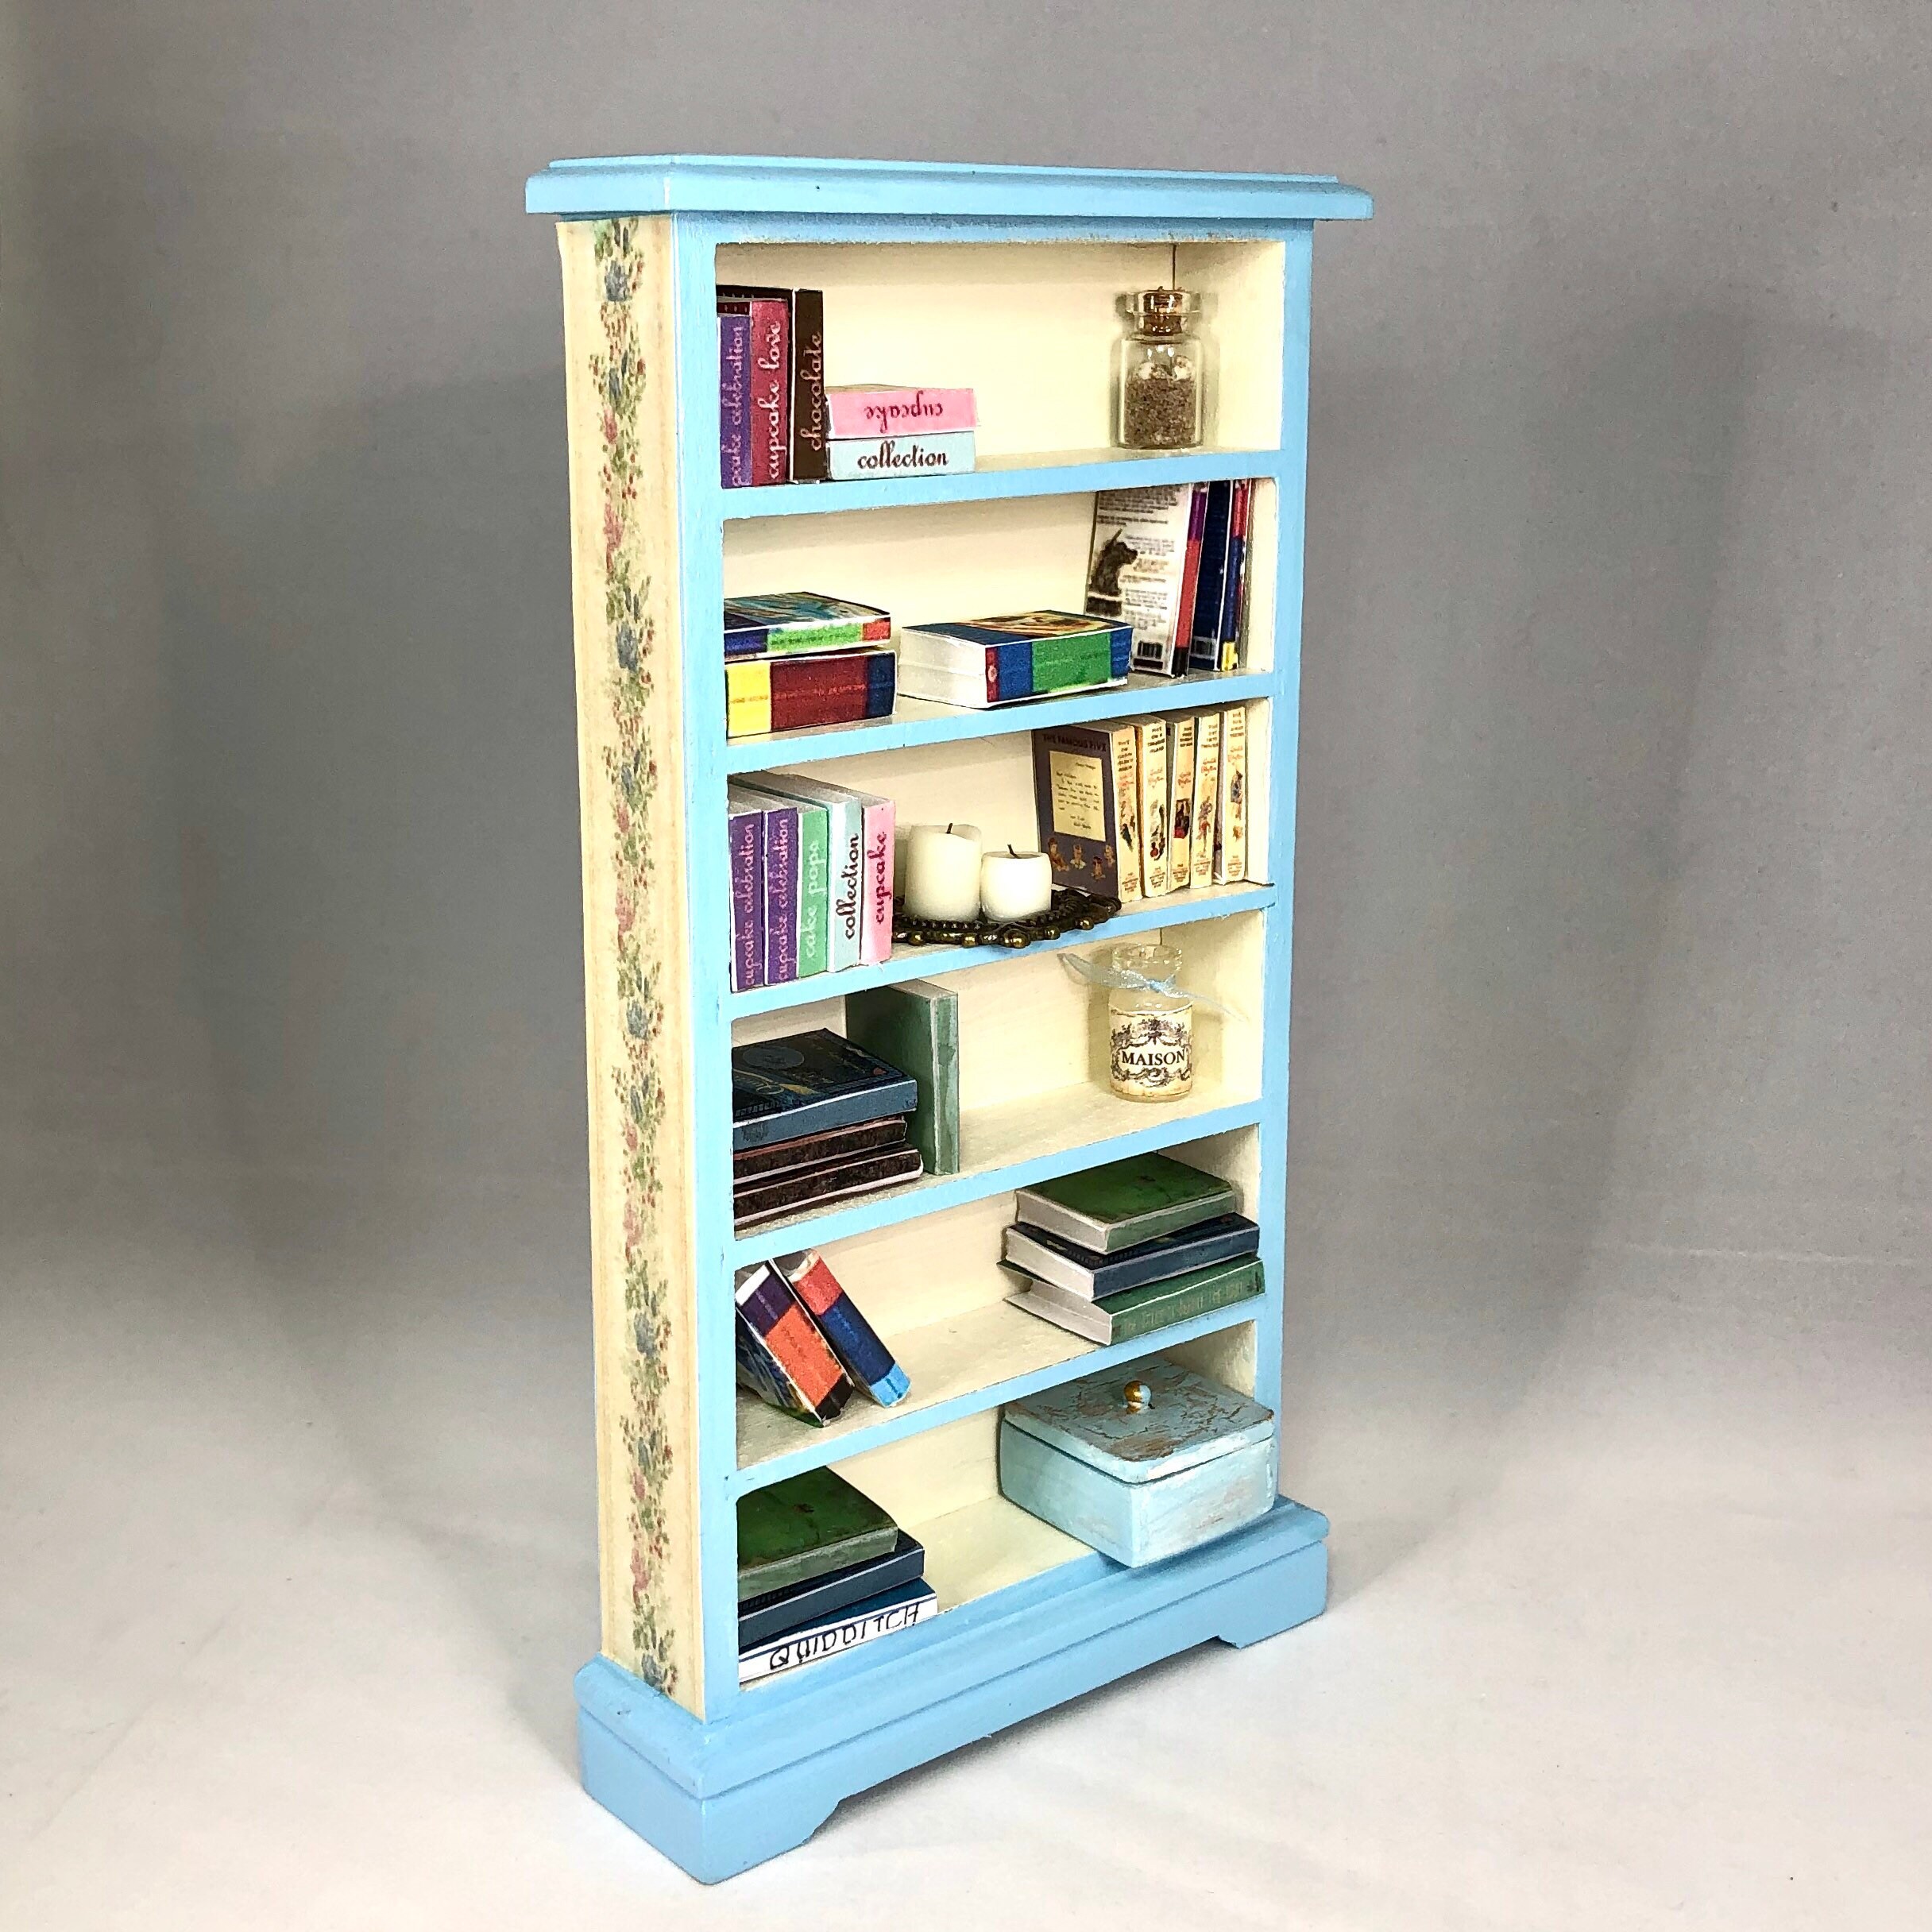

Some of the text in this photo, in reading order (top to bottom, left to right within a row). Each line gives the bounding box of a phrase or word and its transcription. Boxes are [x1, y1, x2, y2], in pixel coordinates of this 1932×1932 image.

[721, 325, 744, 426] celebration
[757, 320, 786, 480] cupcake love
[800, 330, 823, 452] chocolate
[865, 389, 944, 434] cupcake
[856, 440, 949, 470] collection
[734, 823, 763, 986] cupcake celebration
[769, 818, 797, 980] cupcake celebration
[799, 840, 827, 958] cake pops
[835, 833, 860, 940] collection
[867, 831, 892, 924] cupcake
[1121, 1049, 1185, 1066] MAISON
[769, 1602, 922, 1670] QUIDDITCH
